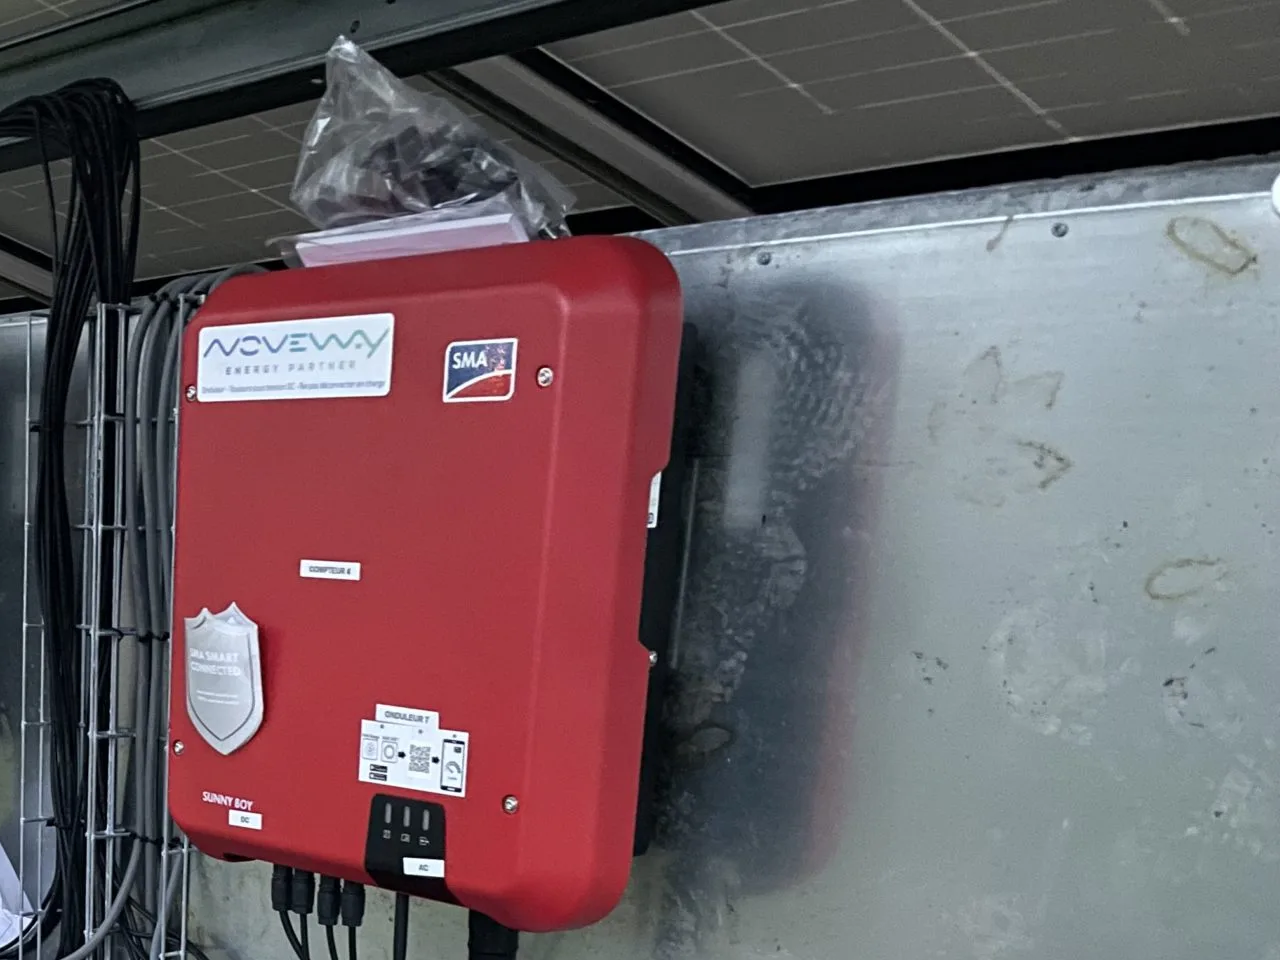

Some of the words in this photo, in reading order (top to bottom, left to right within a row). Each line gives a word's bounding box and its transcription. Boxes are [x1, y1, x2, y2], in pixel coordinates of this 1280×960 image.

[203, 328, 390, 359] NOVEWAY
[224, 363, 280, 376] ENERGY
[288, 359, 357, 373] PARTNER
[451, 350, 489, 370] SMA
[205, 650, 240, 663] SMART
[190, 660, 241, 677] CONNECTED
[202, 791, 233, 807] SUNNY
[234, 797, 253, 811] BOY
[240, 815, 250, 824] DC
[418, 863, 429, 872] AC
